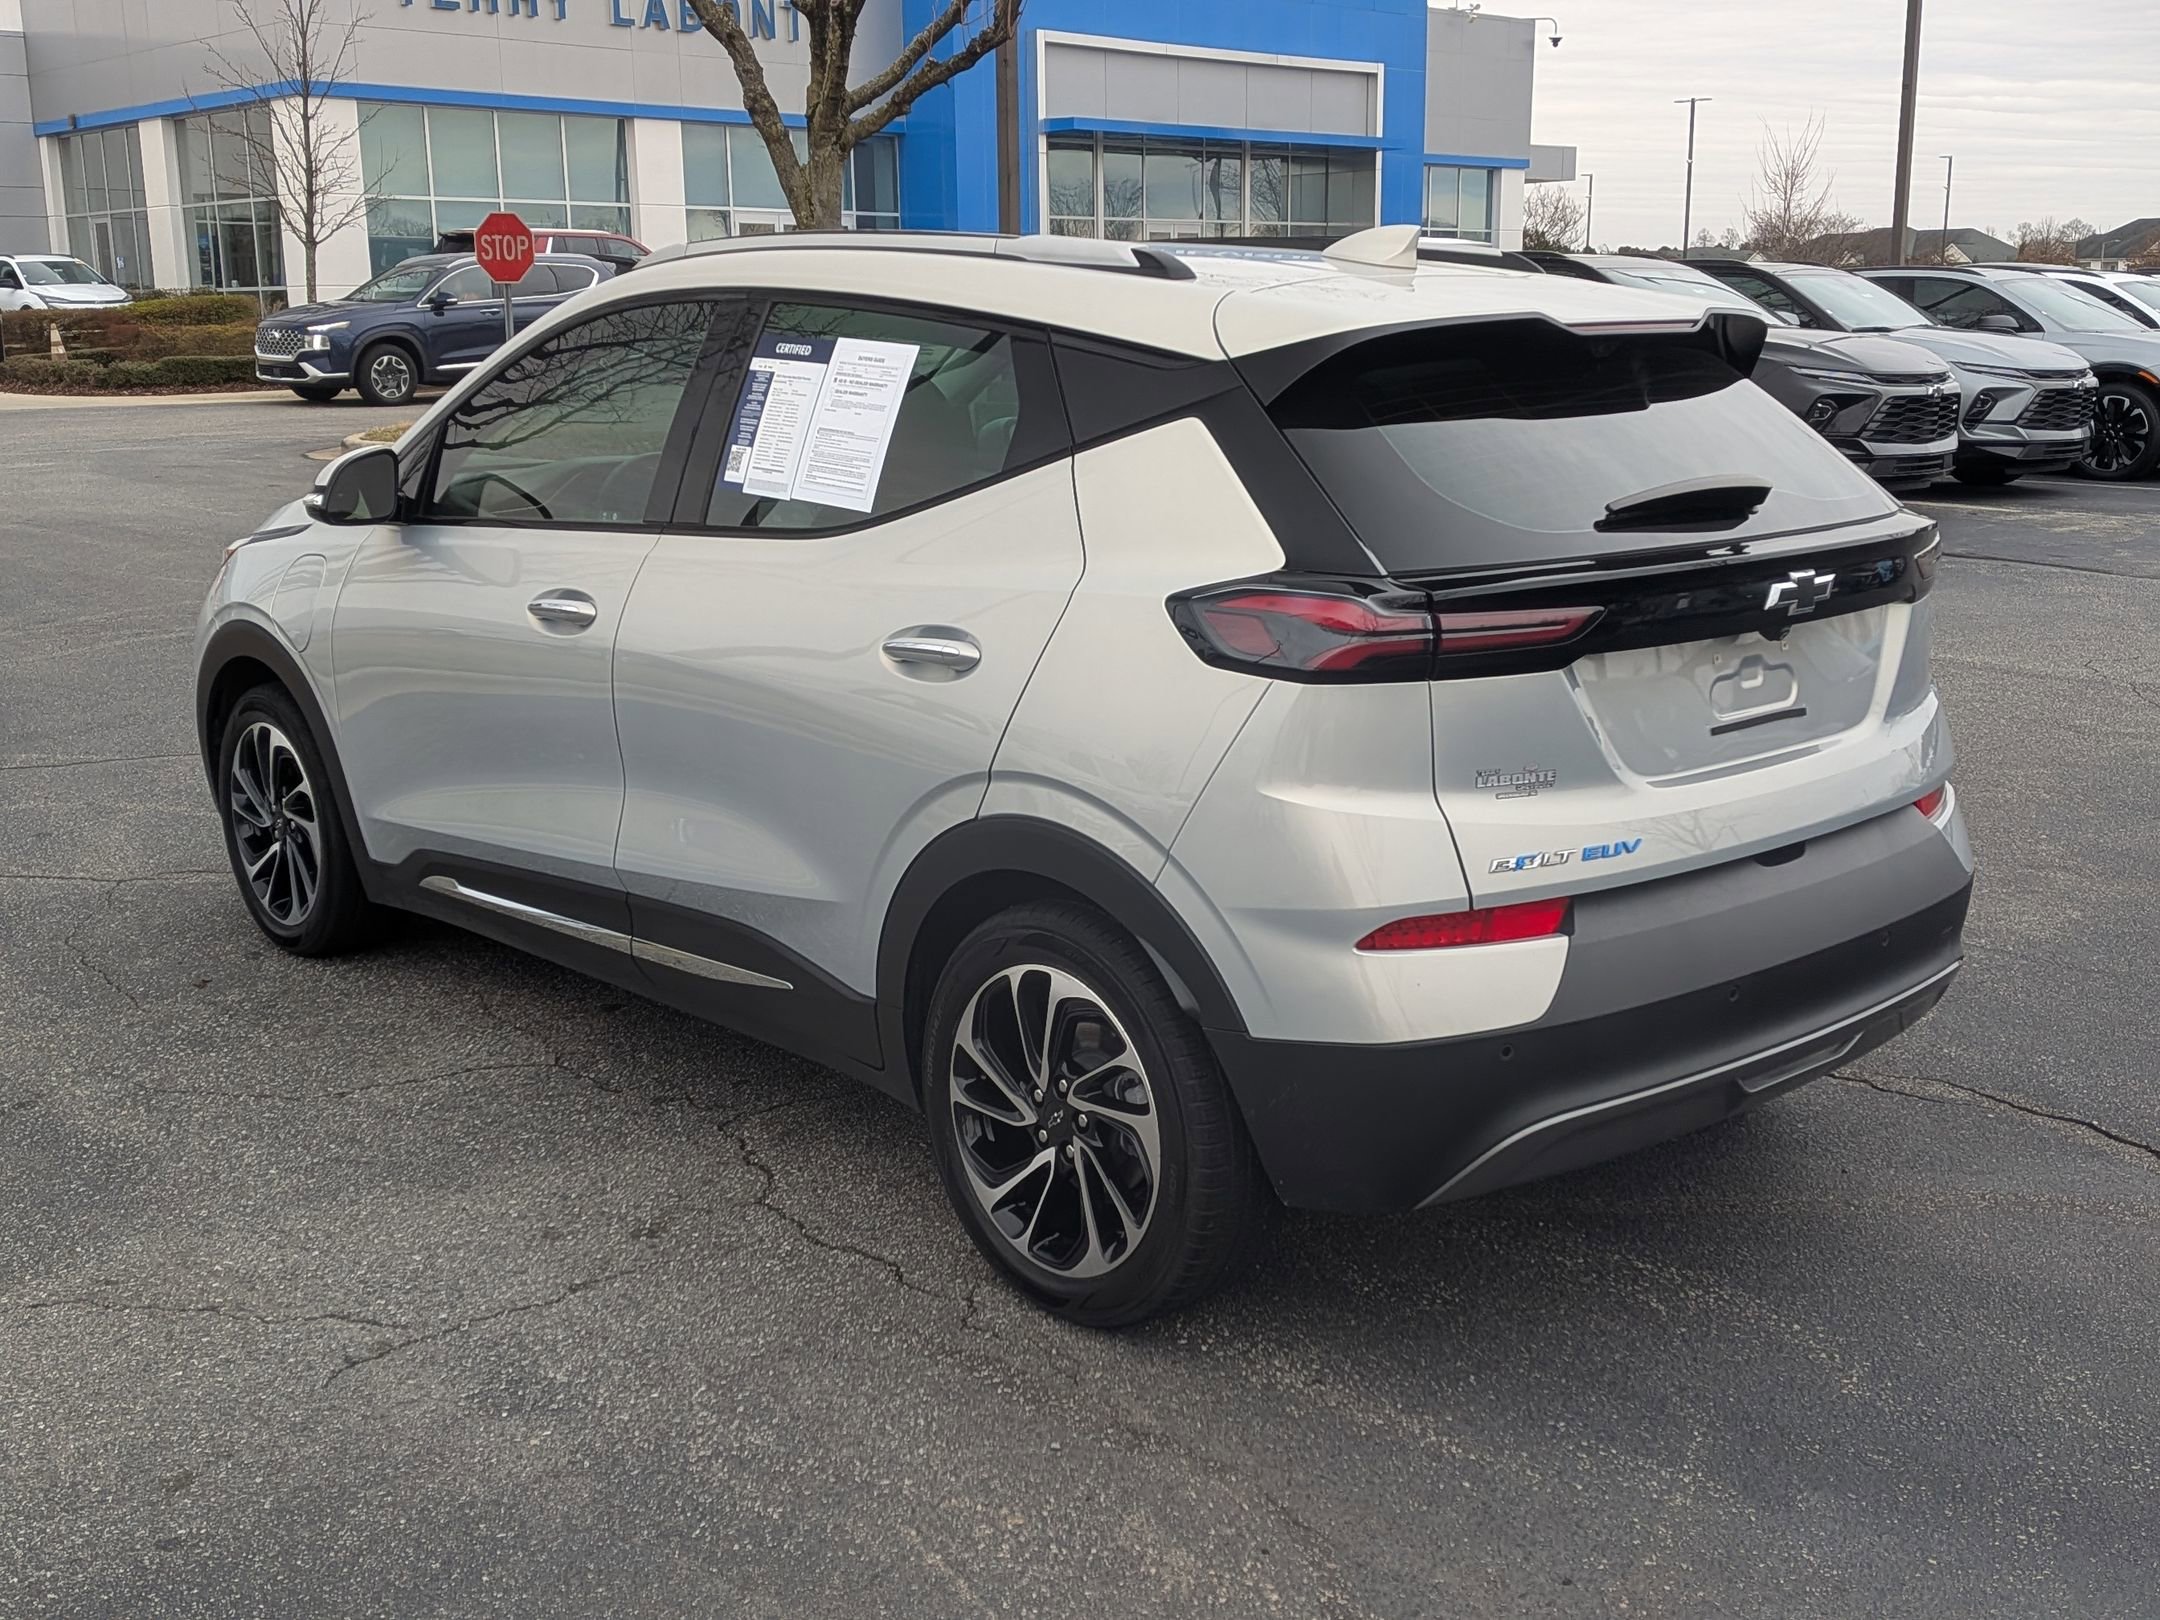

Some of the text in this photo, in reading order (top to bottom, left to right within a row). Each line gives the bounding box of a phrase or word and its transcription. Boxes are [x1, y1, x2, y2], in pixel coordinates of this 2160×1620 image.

[481, 234, 529, 261] STOP
[776, 342, 812, 356] CERTIFIED
[1475, 769, 1557, 788] LABONTE
[1489, 838, 1643, 873] BOLT EUV
